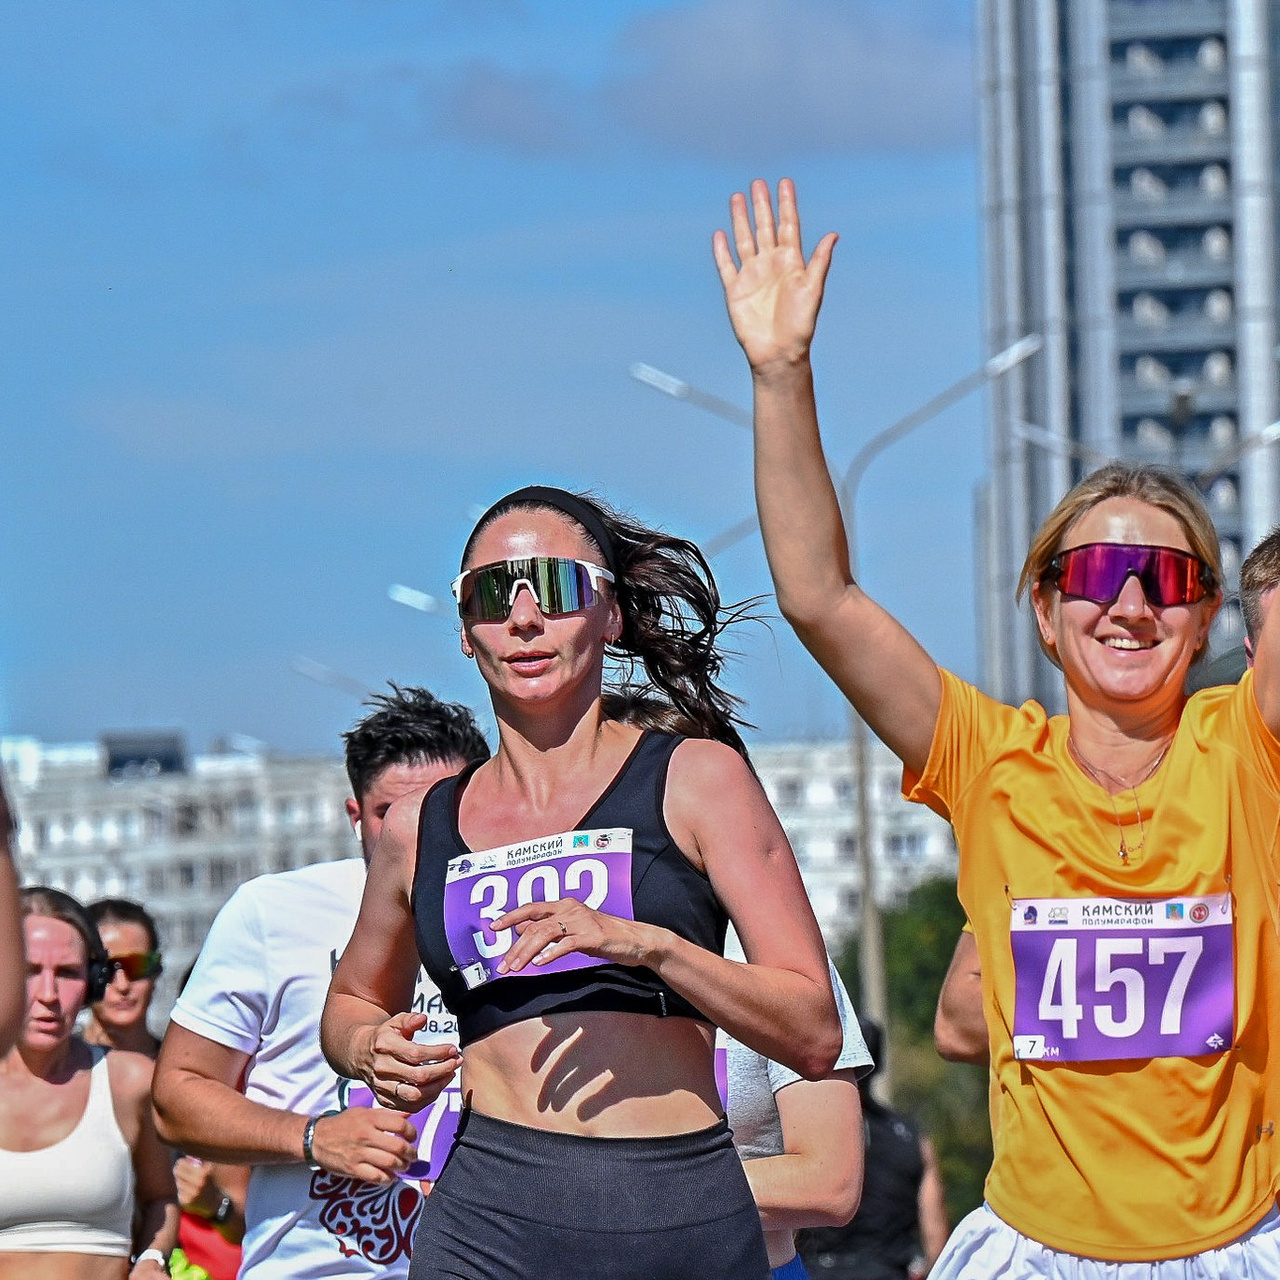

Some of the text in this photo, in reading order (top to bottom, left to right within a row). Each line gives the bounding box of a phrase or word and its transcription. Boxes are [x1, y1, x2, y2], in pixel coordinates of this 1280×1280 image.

[507, 836, 563, 859] КАМСКИЙ
[506, 848, 562, 866] ПОЛУМАРАФОН
[1082, 902, 1154, 917] КАМСКИЙ
[1082, 918, 1154, 926] ПОЛУМАРАФОН
[1038, 936, 1204, 1039] 457
[1028, 1040, 1037, 1054] 7
